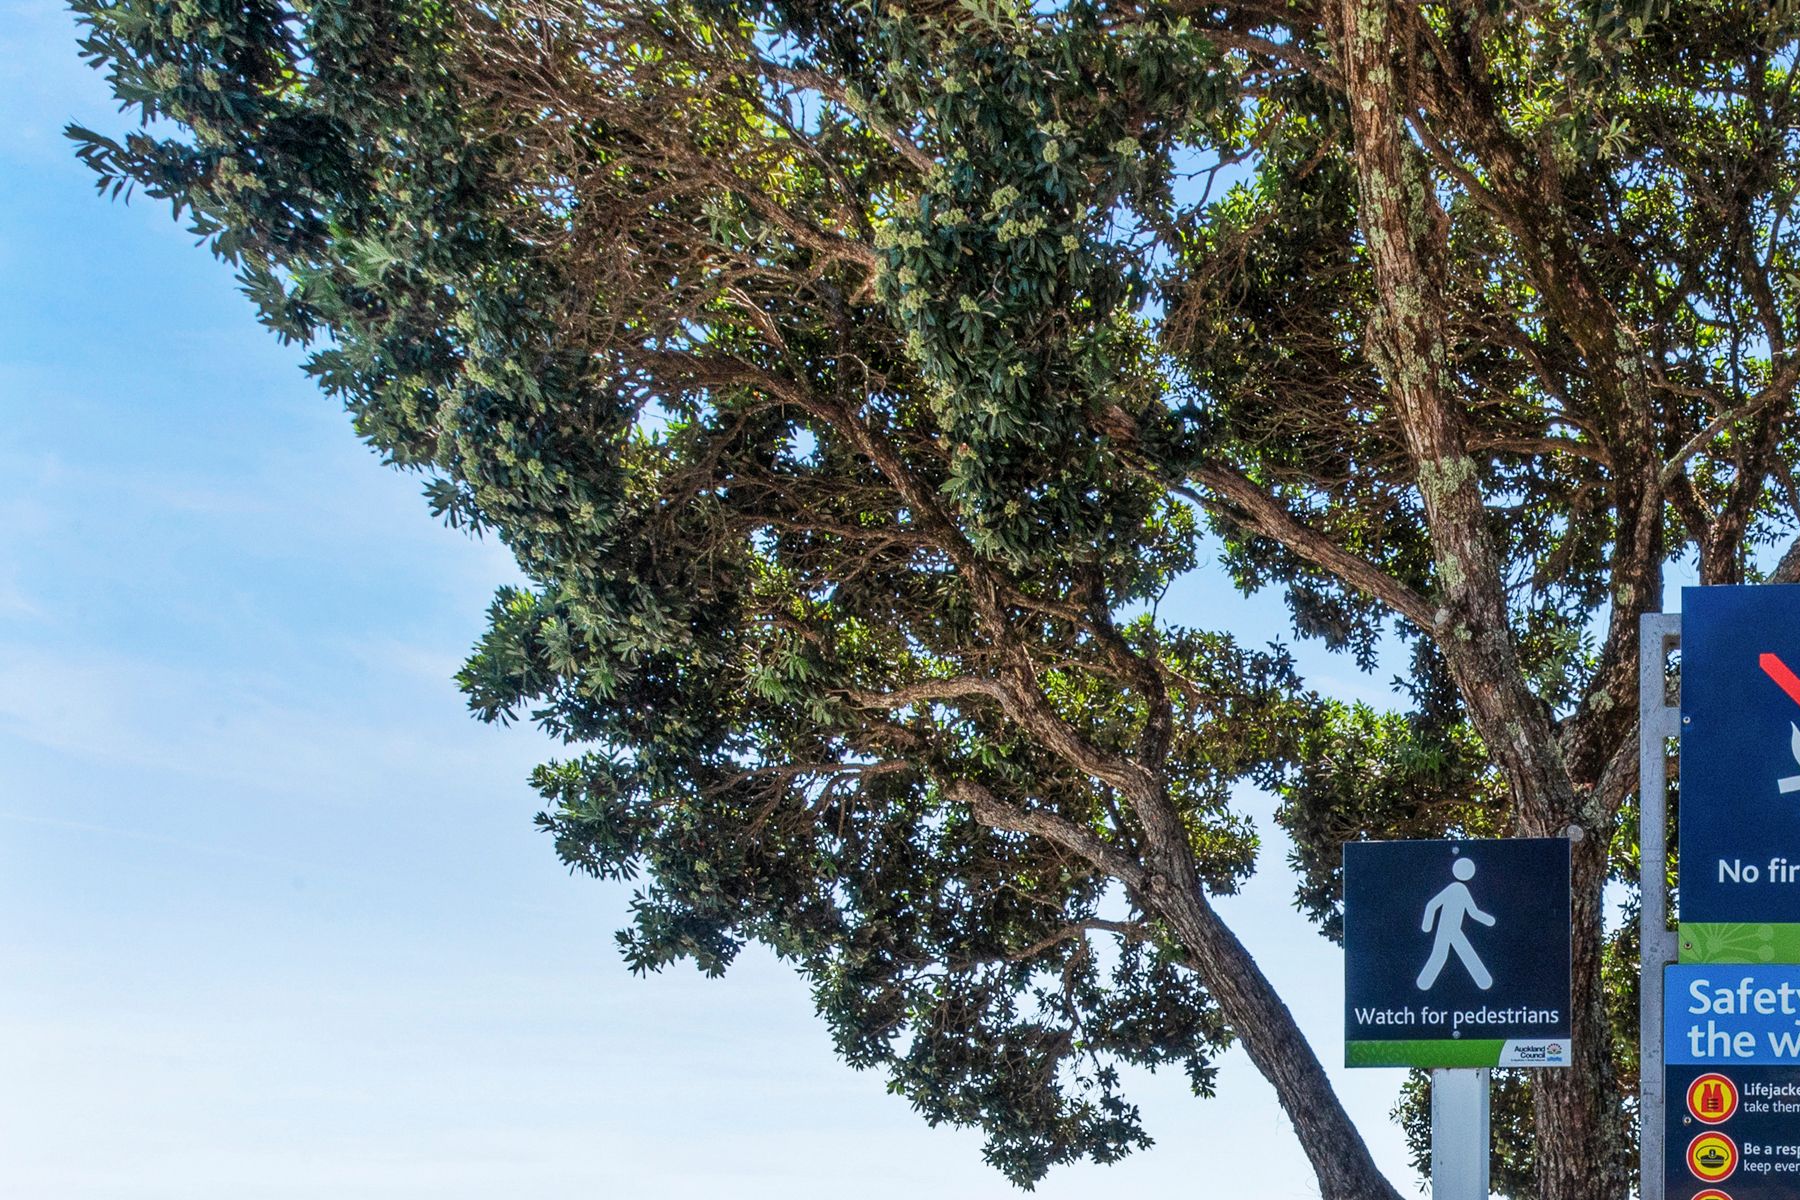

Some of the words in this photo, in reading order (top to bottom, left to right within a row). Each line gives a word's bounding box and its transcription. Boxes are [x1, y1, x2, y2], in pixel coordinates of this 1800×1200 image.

[1719, 860, 1759, 883] No
[1355, 1006, 1415, 1024] Watch
[1421, 1006, 1448, 1024] for
[1454, 1005, 1559, 1029] pedestrians
[1687, 1020, 1756, 1057] the
[1744, 1100, 1769, 1112] take
[1744, 1143, 1761, 1155] Be
[1764, 1146, 1772, 1155] a
[1744, 1160, 1771, 1175] keep
